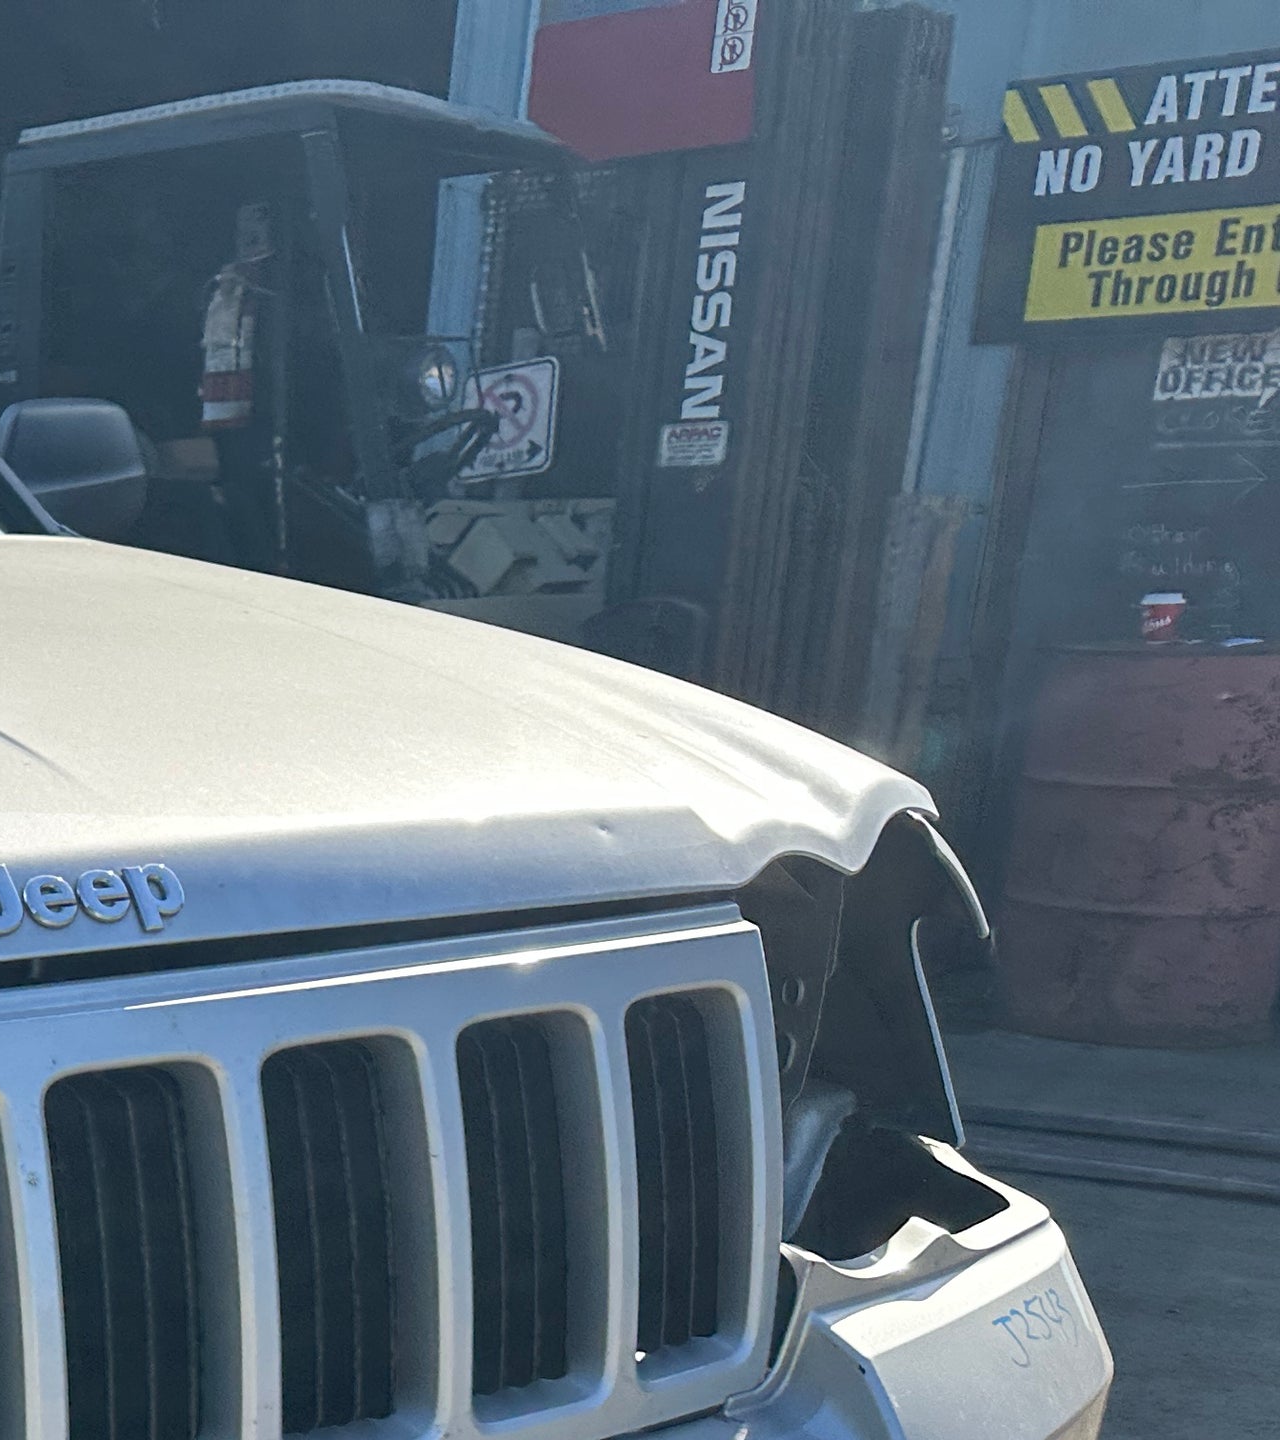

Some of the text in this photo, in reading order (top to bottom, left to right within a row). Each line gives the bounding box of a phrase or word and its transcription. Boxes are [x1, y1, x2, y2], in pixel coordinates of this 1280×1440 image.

[1144, 63, 1280, 125] ATTE
[1034, 129, 1261, 196] NO YARD
[1058, 229, 1195, 269] Please
[681, 181, 746, 420] NISSAN
[1088, 259, 1256, 308] Through
